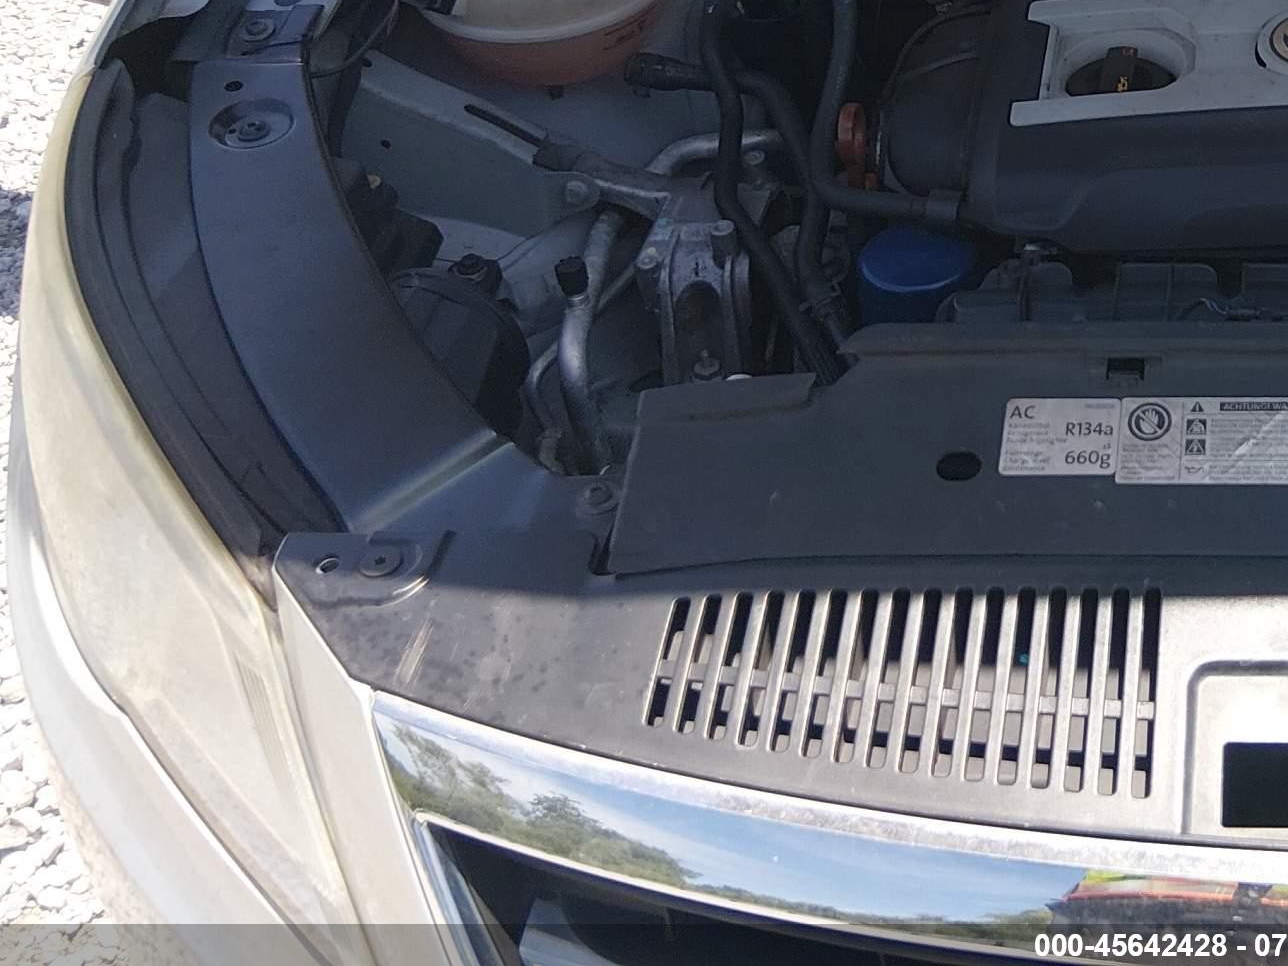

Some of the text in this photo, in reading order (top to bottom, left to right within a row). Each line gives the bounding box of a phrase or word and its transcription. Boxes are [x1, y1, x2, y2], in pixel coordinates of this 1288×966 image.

[1010, 405, 1036, 419] AC
[1065, 422, 1114, 436] R134a
[1064, 450, 1111, 470] 660g
